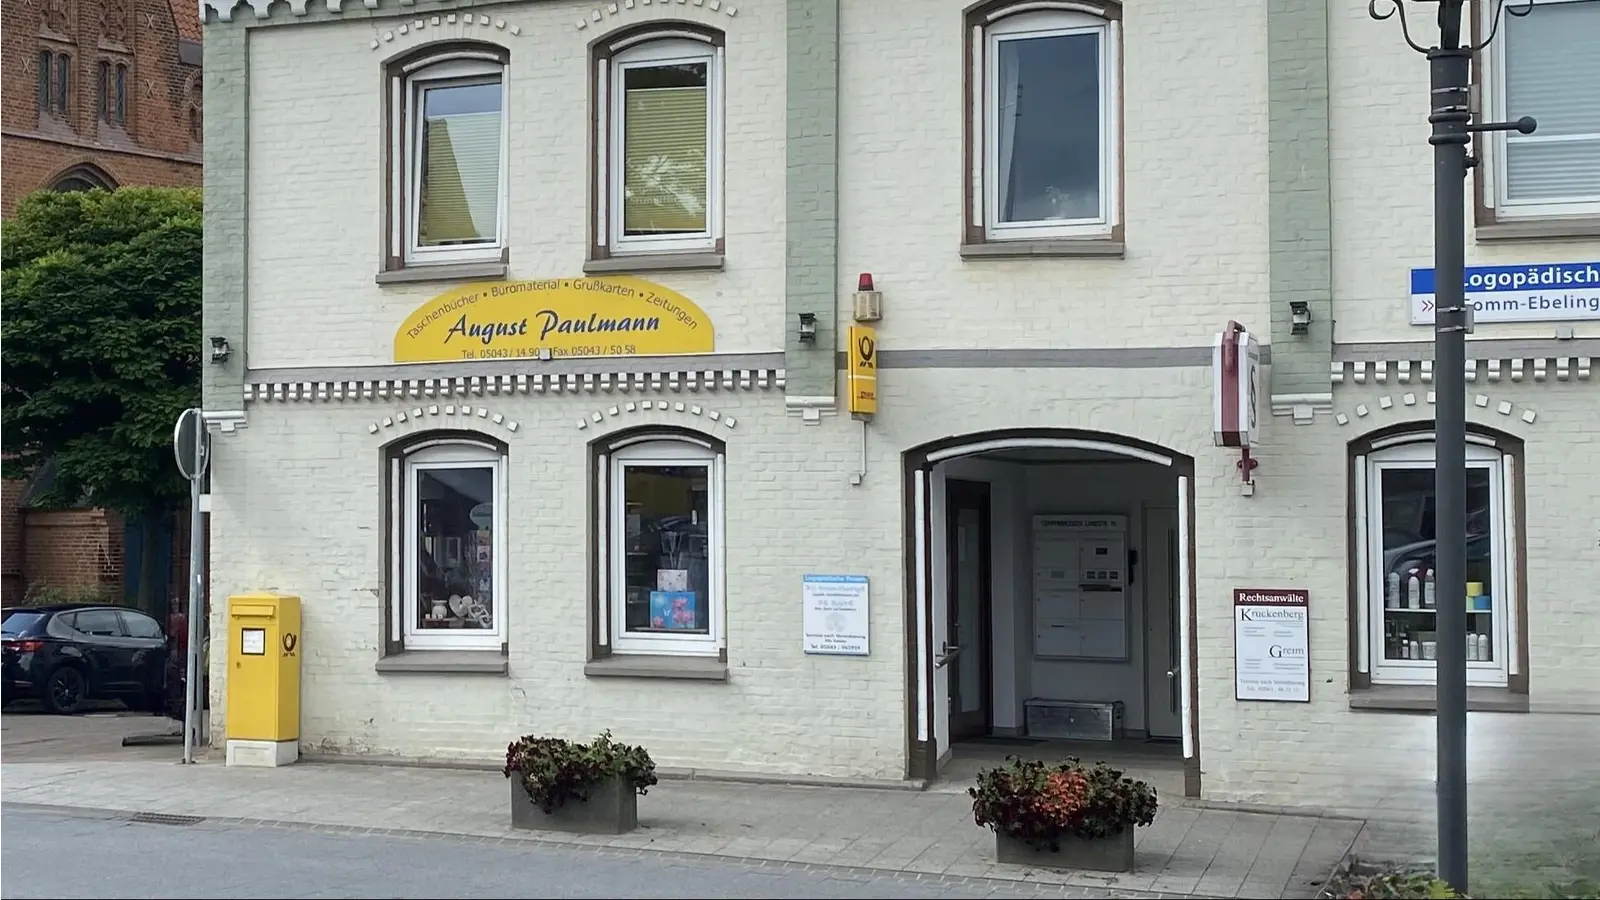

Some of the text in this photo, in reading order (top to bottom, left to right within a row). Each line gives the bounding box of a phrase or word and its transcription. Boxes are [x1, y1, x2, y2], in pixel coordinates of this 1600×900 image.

[1464, 265, 1599, 290] ogopädisch
[406, 278, 698, 339] Taschenbücher Büromaterial Grußkarten Zeitungen
[1464, 294, 1599, 312] omm-Ebeling
[443, 309, 660, 344] August Paulmann
[461, 349, 477, 359] Tel.
[480, 348, 508, 358] 05043
[516, 348, 526, 357] 14
[553, 346, 569, 356] Fax
[571, 345, 601, 356] 05043
[610, 345, 622, 354] 50
[624, 344, 636, 354] 58
[1239, 593, 1304, 602] Rechtsanwälte
[1240, 608, 1304, 621] Kruckenberg
